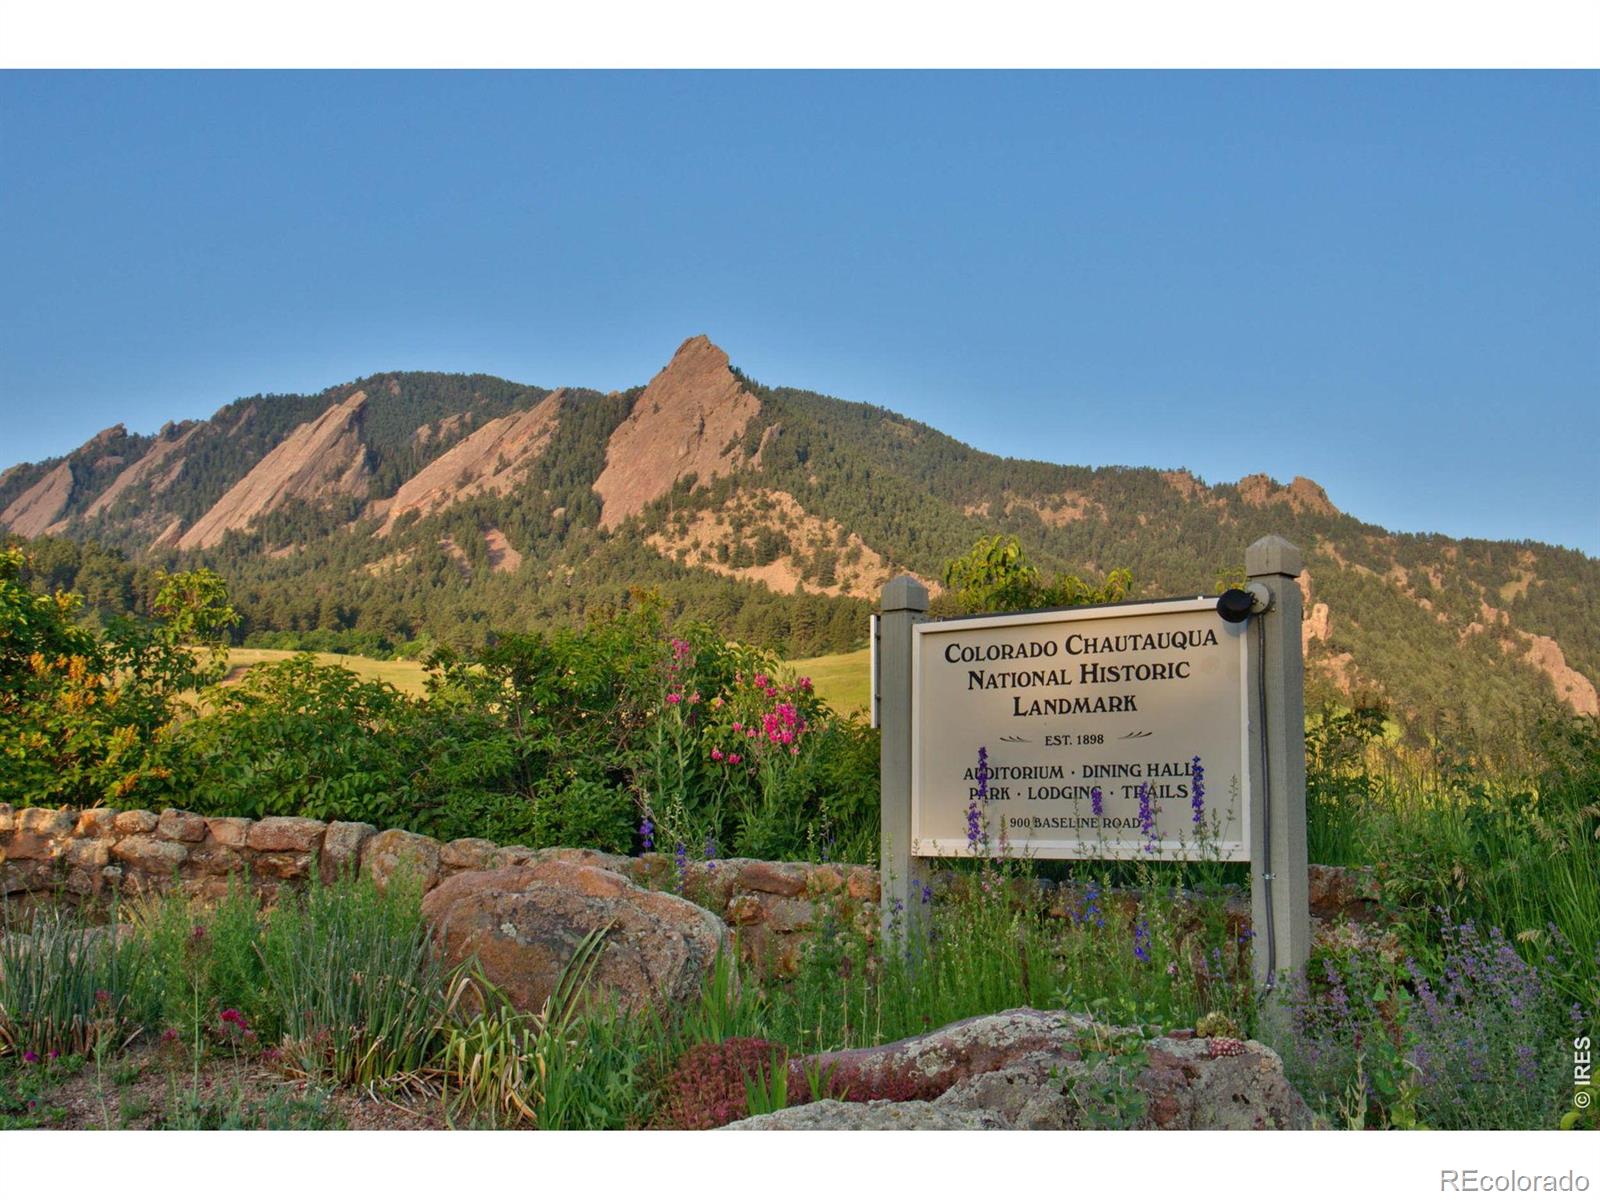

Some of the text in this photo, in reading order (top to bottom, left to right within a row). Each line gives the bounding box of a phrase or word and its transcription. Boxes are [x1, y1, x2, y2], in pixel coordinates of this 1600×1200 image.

[944, 628, 1218, 664] COLORADO CHAUTAUQUA
[967, 660, 1190, 690] NATIONAL HISTORIC
[1013, 694, 1138, 717] LANDMARK
[1044, 734, 1104, 746] EST. 1898
[1082, 763, 1142, 779] DINING
[1009, 817, 1141, 829] 900 BASELINE ROAD
